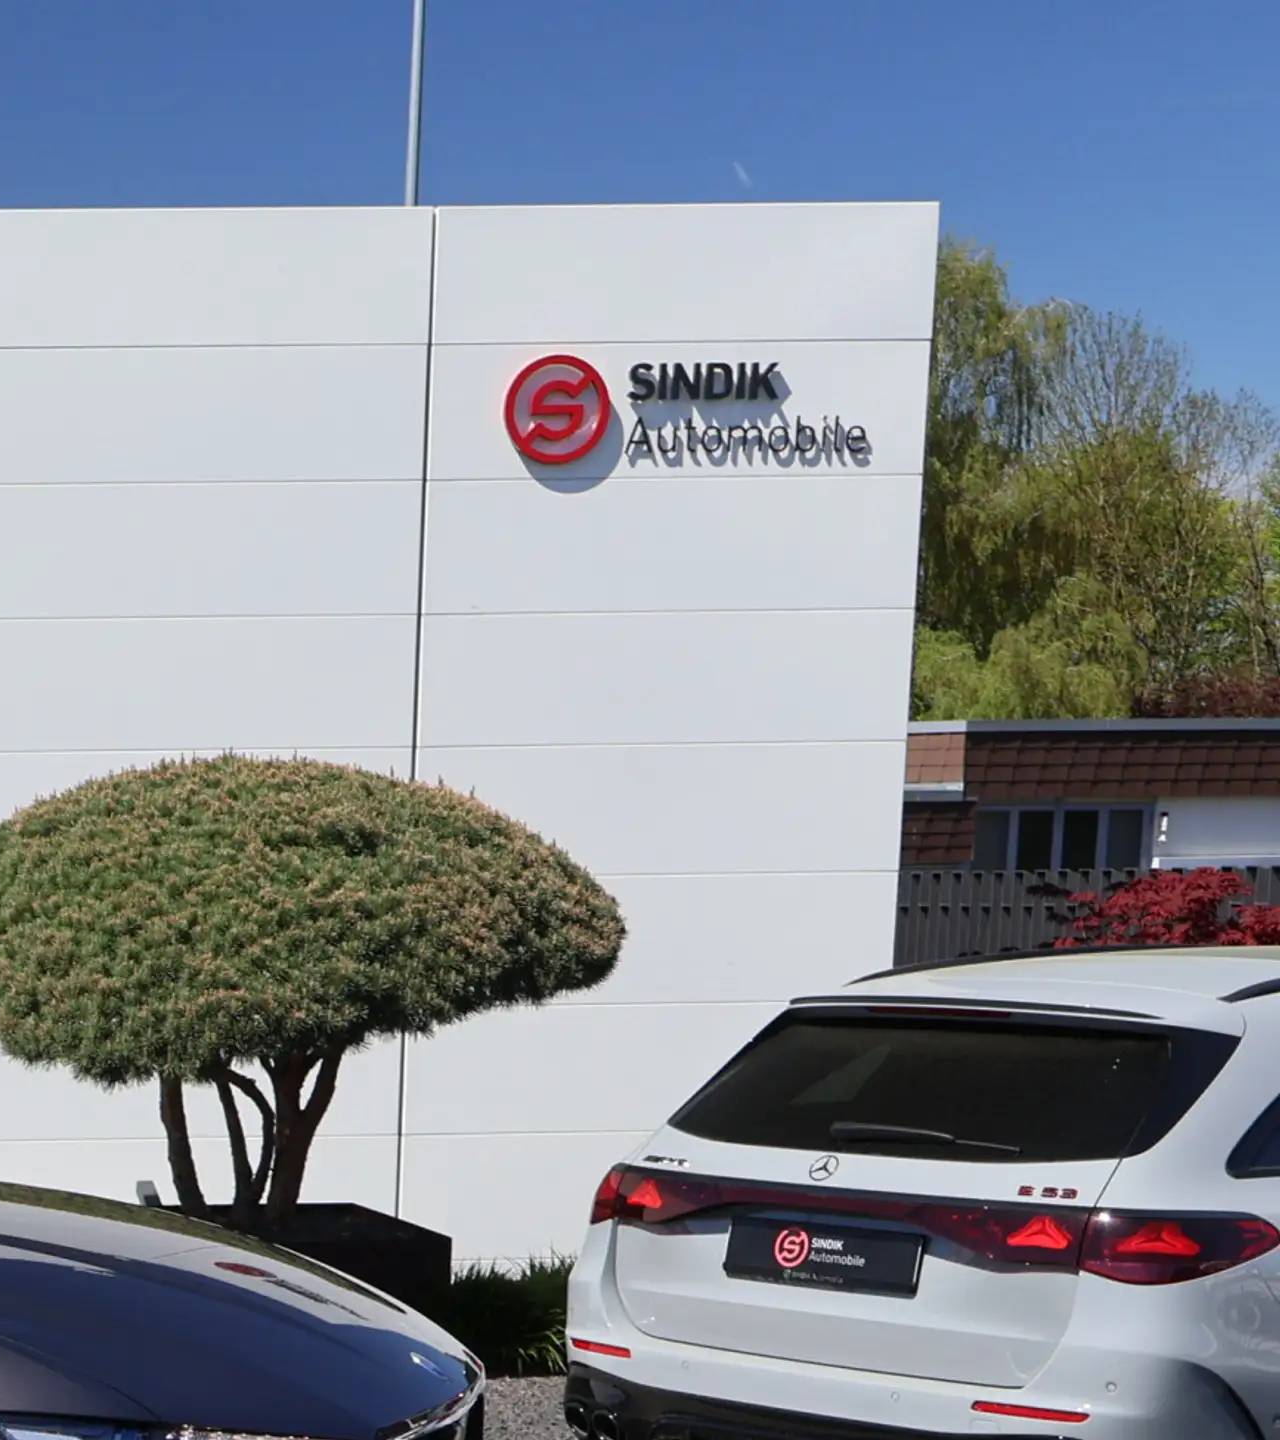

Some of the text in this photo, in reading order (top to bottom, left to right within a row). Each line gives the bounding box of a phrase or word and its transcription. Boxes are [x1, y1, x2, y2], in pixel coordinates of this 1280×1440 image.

[627, 361, 779, 401] SINDIK
[626, 415, 867, 453] Automobile
[1017, 1185, 1078, 1200] E 53
[811, 1237, 844, 1250] SINDIK
[808, 1251, 865, 1267] Automobile
